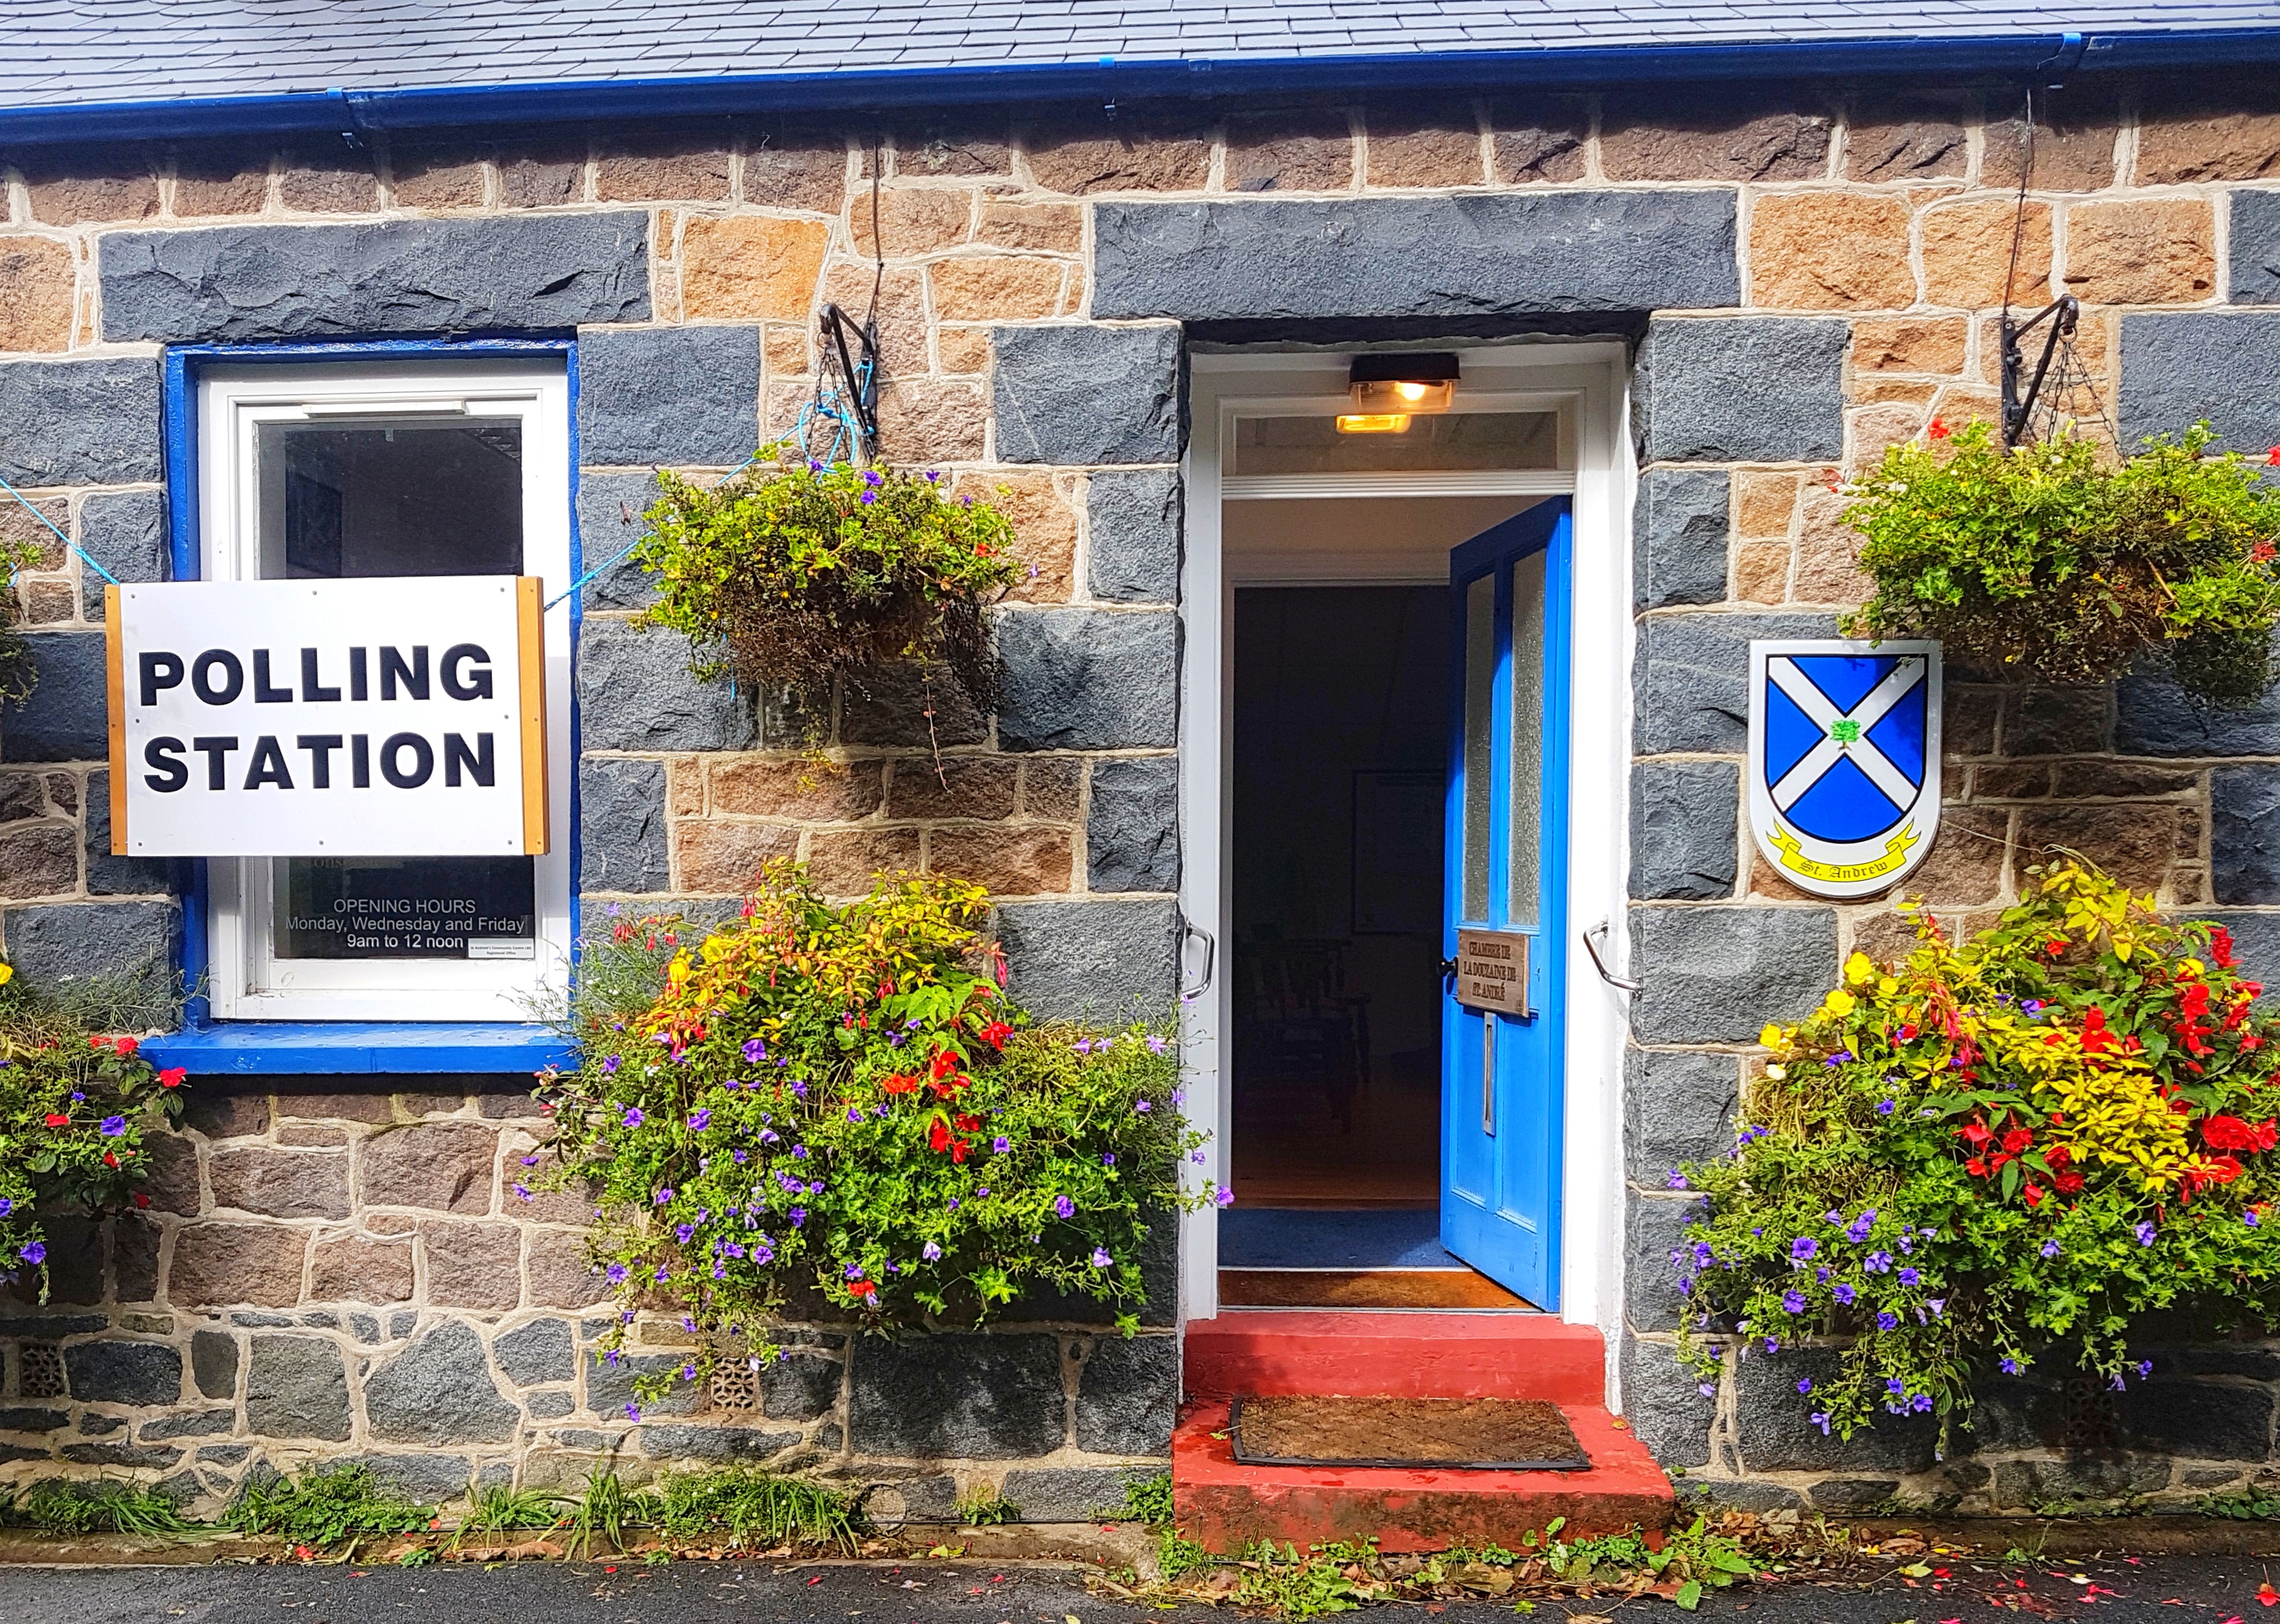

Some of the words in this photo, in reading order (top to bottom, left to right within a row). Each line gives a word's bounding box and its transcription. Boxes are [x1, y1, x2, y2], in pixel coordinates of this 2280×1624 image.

[138, 643, 493, 706] POLLING
[143, 731, 496, 793] STATION
[1798, 860, 1822, 876] St.
[1829, 862, 1888, 879] Andrew
[334, 899, 411, 913] OPENING
[416, 899, 476, 913] HOURS
[286, 917, 347, 933] Monday,
[352, 917, 440, 934] Wednesday
[445, 917, 472, 930] and
[478, 917, 525, 934] Friday
[347, 934, 379, 947] 9am
[384, 935, 398, 947] to
[404, 934, 422, 947] 12
[426, 937, 463, 948] noon
[1469, 942, 1501, 959] CHAMBRE
[1501, 945, 1511, 960] DE
[1464, 961, 1472, 975] LA
[1473, 962, 1506, 980] DOUZAINE
[1507, 967, 1516, 982] DE
[1481, 982, 1505, 1001] ANDRÉ
